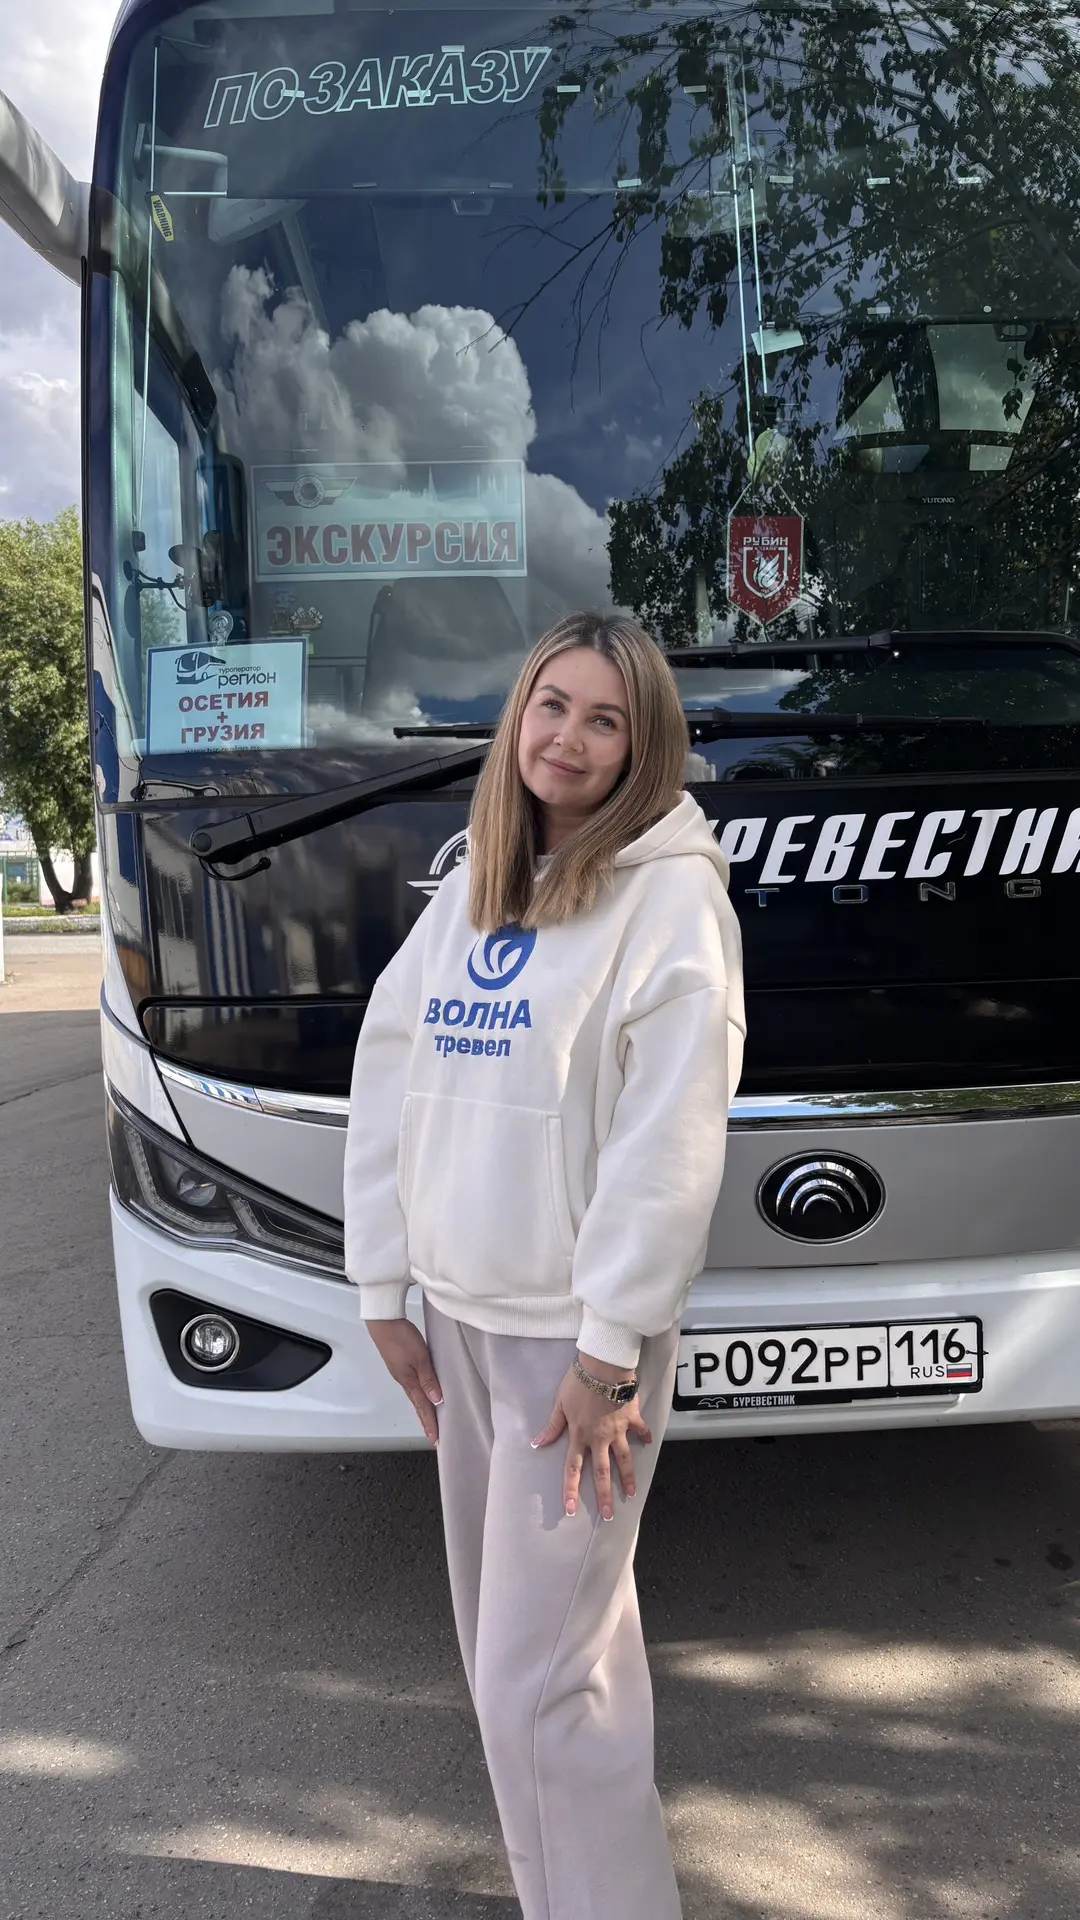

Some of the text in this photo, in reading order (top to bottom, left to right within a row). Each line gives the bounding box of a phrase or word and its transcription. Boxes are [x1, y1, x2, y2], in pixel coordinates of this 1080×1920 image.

[203, 49, 553, 128] ПО ЗАКАЗУ
[152, 199, 172, 238] WARNING
[267, 521, 519, 567] ЭКСКУРСИЯ
[743, 536, 789, 546] РУБИН
[218, 666, 261, 674] туроператор
[178, 691, 269, 713] ОСЕТИЯ
[217, 712, 228, 723] +
[181, 723, 265, 744] ГРУЗИЯ
[424, 998, 532, 1030] ВОЛНА
[434, 1035, 511, 1057] тревел
[894, 1328, 966, 1365] 116
[911, 1365, 945, 1379] RUS
[733, 1395, 796, 1408] БУРЕВЕСТНИК
